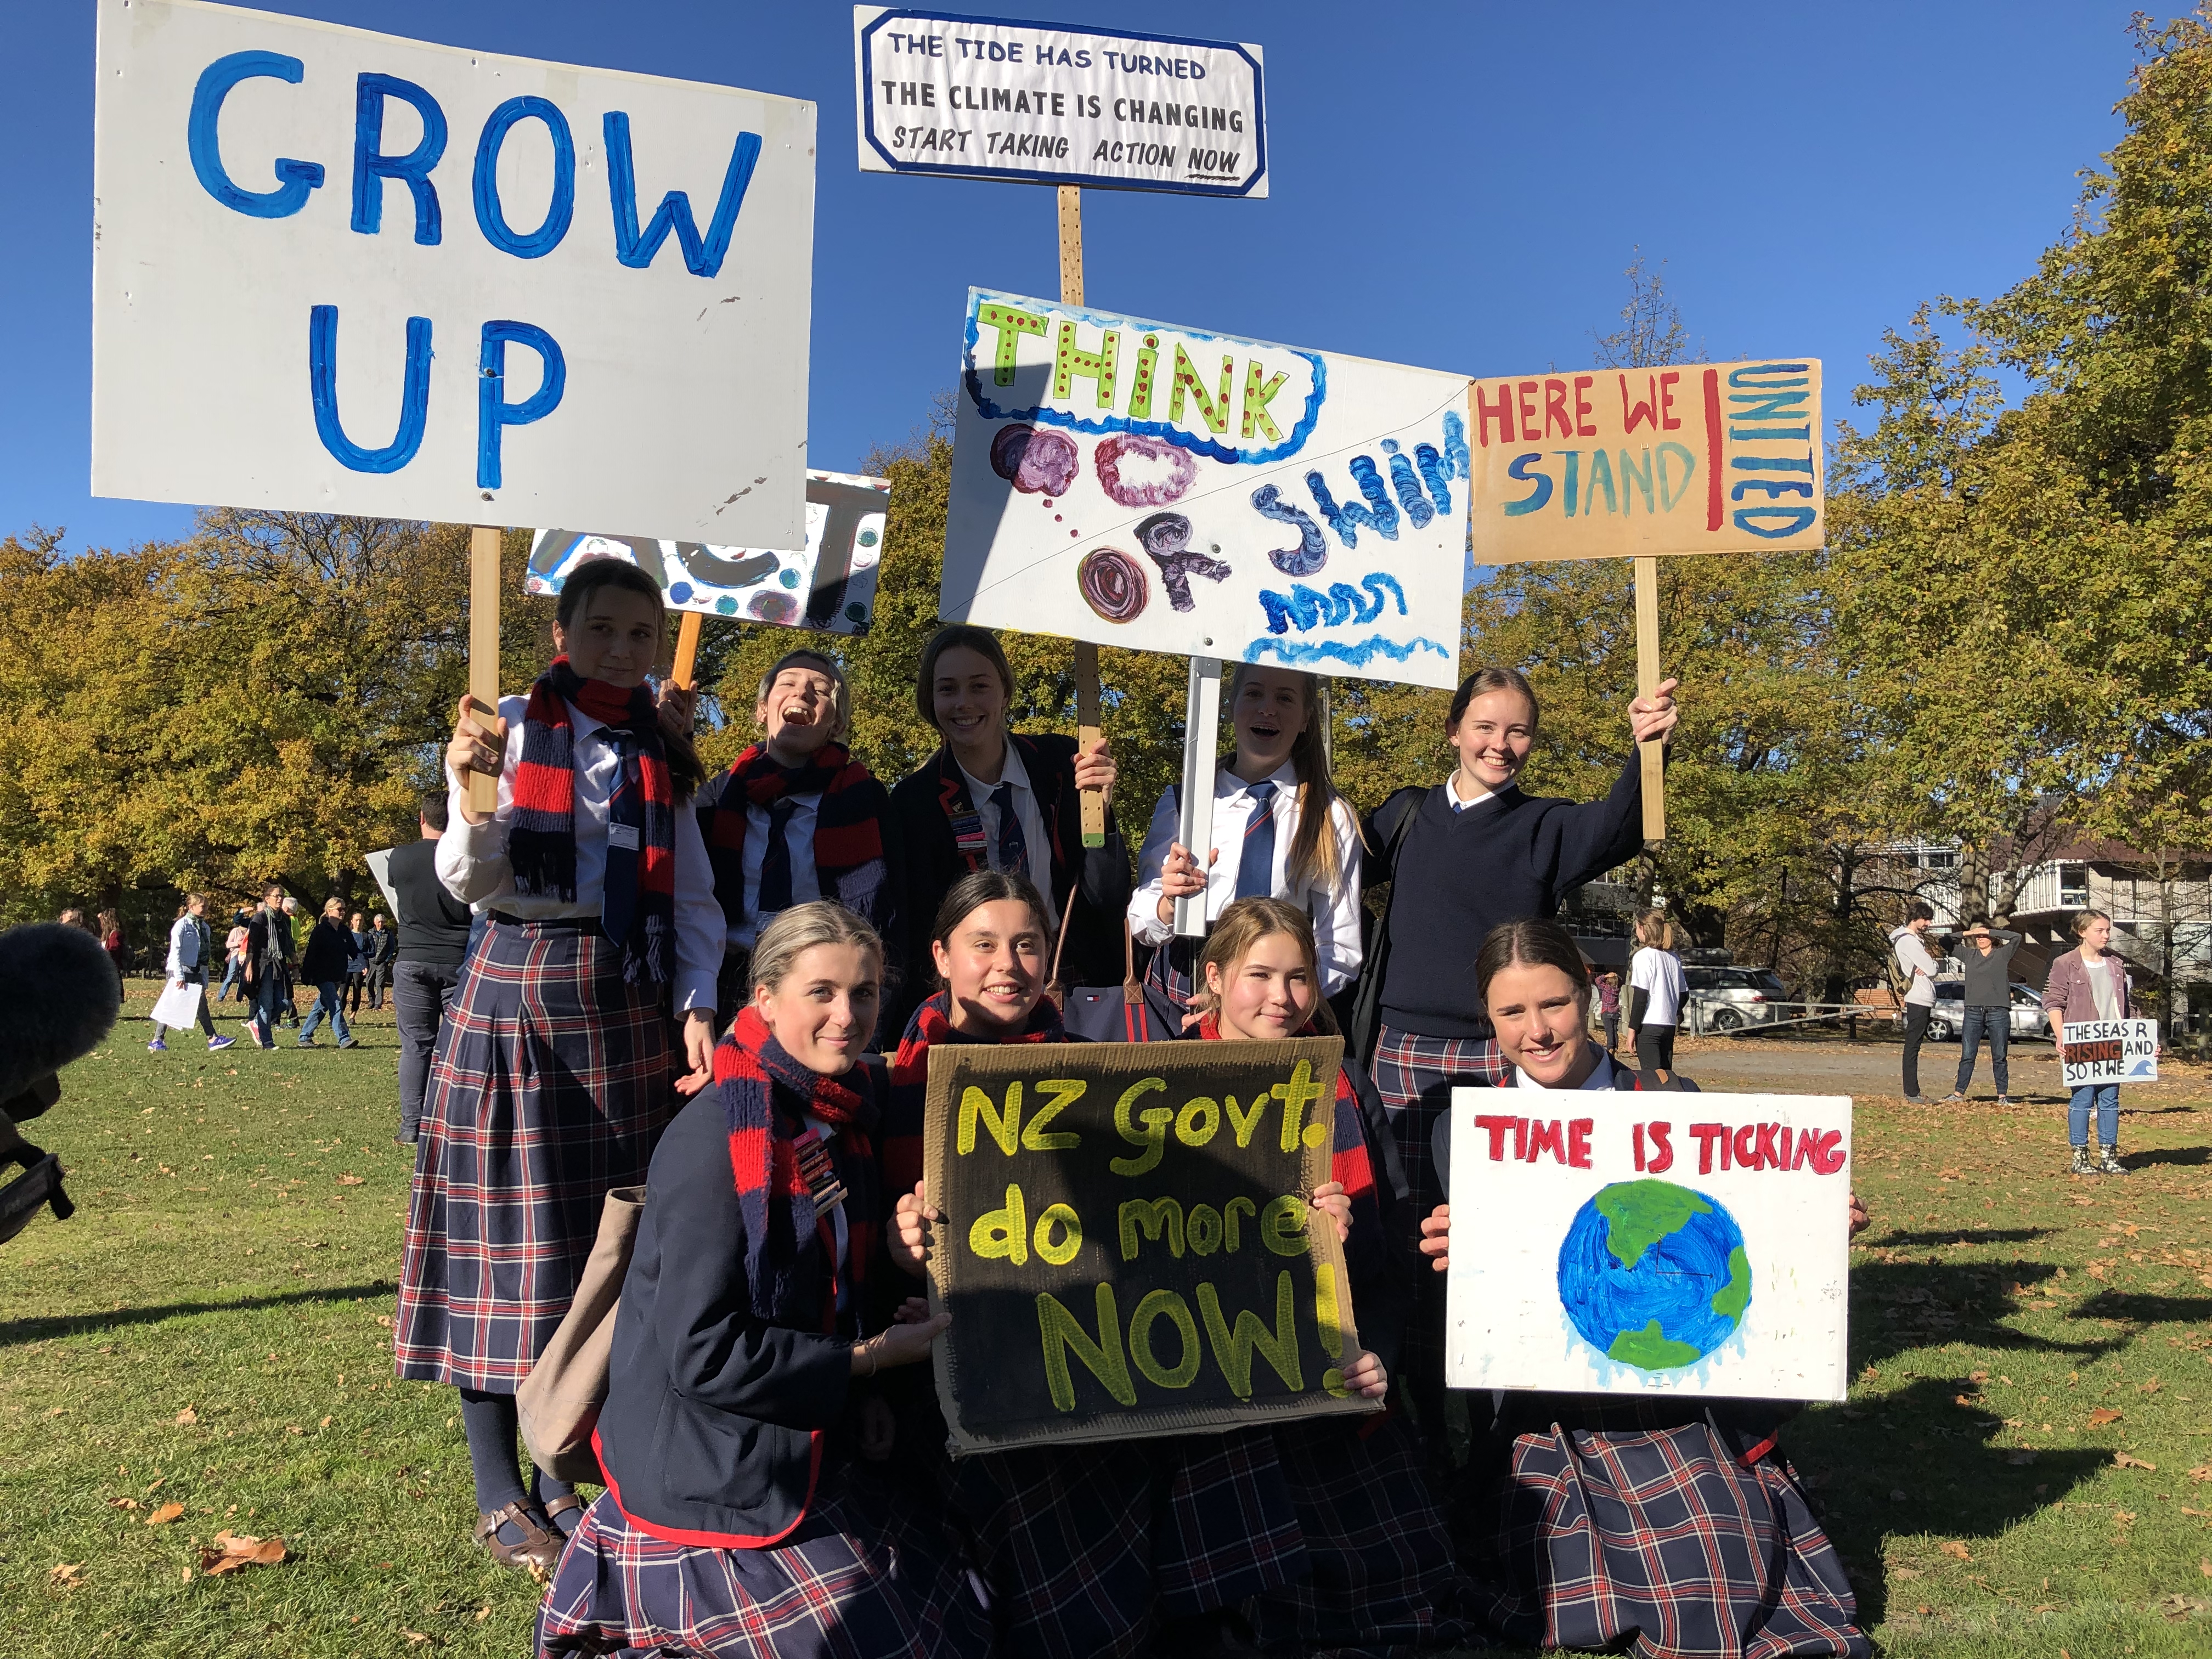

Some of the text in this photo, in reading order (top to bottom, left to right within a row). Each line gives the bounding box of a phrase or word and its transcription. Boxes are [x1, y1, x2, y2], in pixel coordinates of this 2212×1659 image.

[887, 32, 1206, 80] THE TIDE HAS TURNED
[881, 80, 1244, 134] THE CLIMATE IS CHANGING
[188, 49, 763, 279] GROW
[891, 125, 1242, 175] START TAKING ACTION NOW
[309, 304, 567, 490] UP
[1476, 371, 1682, 448] HERE WE
[1499, 442, 1697, 520] STAND
[1726, 363, 1817, 540] UNITED
[1076, 511, 1232, 625] OR
[2064, 1022, 2148, 1042] THE SEAS R
[2064, 1040, 2153, 1064] RISING AND
[2066, 1060, 2125, 1081] SO R WE
[957, 1058, 1327, 1176] NZ Govt.
[1474, 1114, 1847, 1176] TIME IS TICKING
[968, 1183, 1311, 1266] do more
[1035, 1262, 1354, 1412] NOW!
